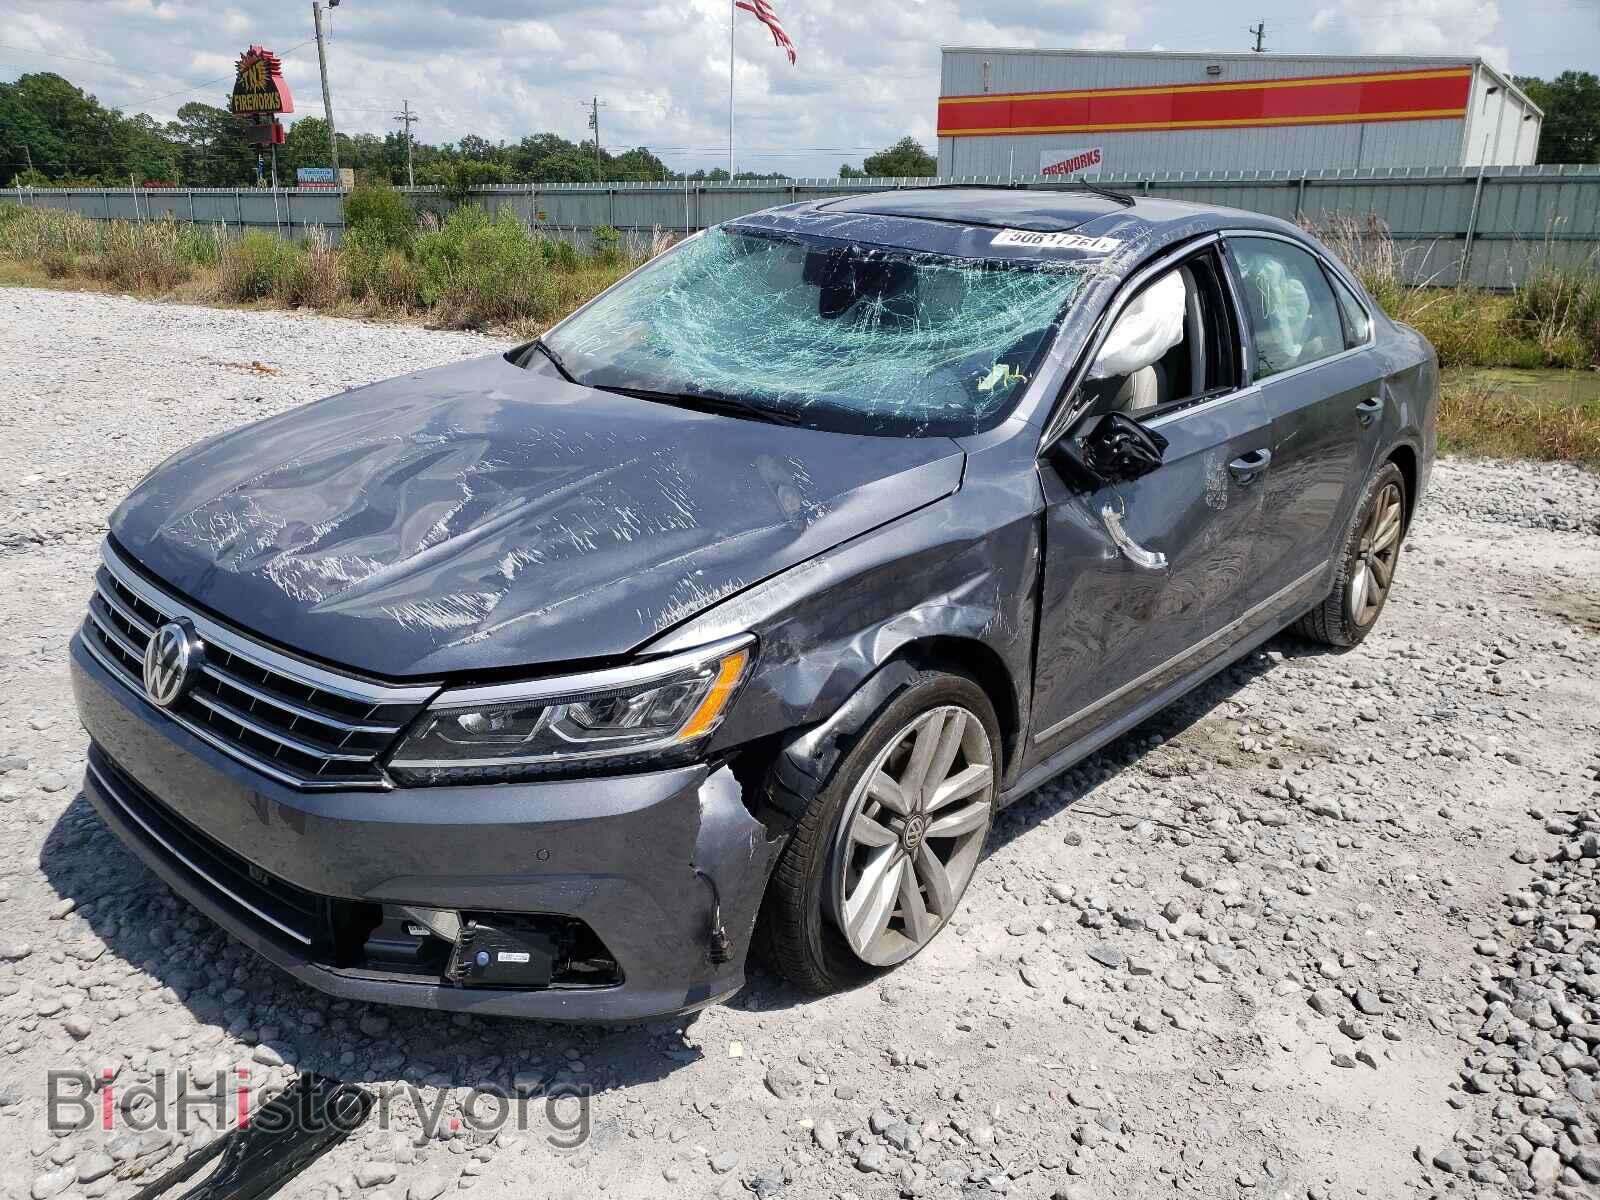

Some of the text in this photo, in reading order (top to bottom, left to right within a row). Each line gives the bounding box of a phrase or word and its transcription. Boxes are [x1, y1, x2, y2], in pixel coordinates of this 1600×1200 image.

[241, 61, 264, 91] TNT
[234, 92, 281, 111] FIREWORKS
[1042, 149, 1101, 175] FIREWORKS
